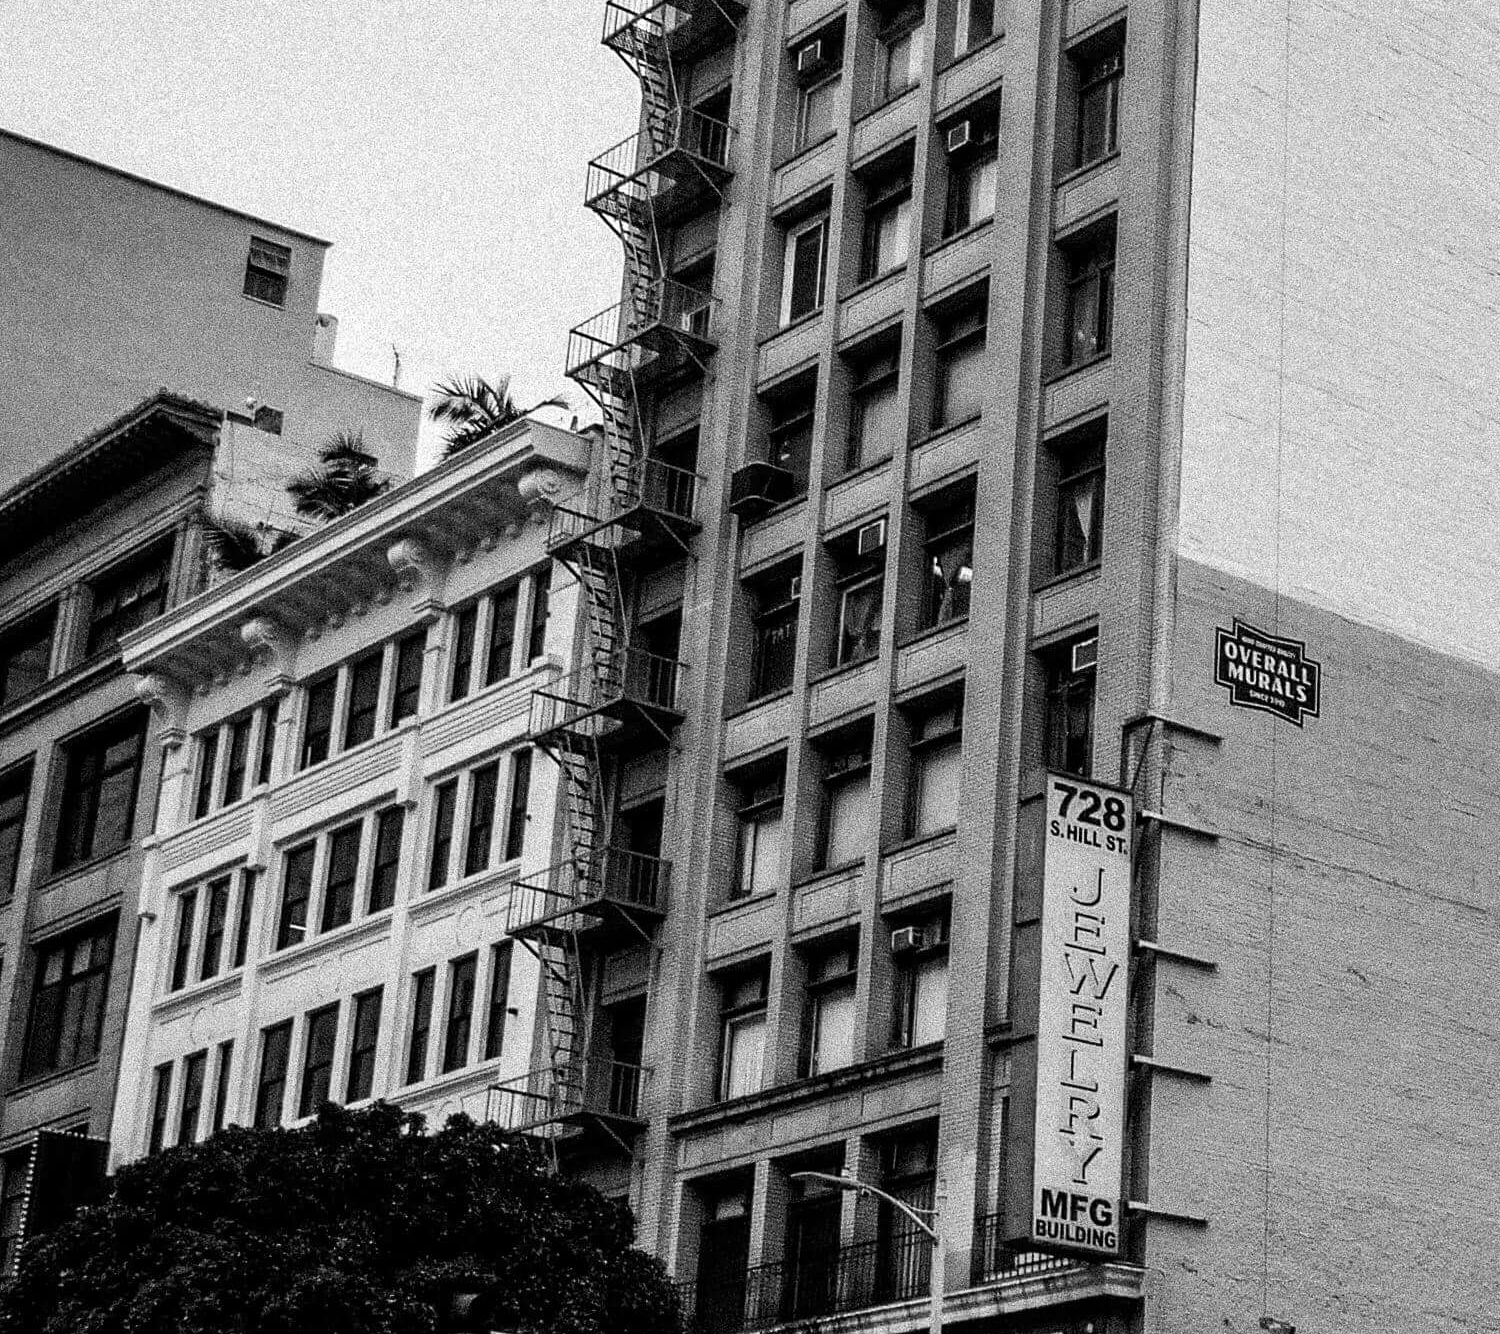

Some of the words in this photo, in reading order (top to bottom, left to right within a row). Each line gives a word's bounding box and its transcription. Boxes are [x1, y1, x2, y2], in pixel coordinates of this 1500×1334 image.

[1224, 640, 1313, 687] OVERALL
[1227, 661, 1307, 704] MURALS
[1054, 781, 1125, 832] 728
[1050, 819, 1064, 838] S.
[1066, 824, 1101, 848] HILL
[1106, 834, 1128, 855] ST.
[1041, 1188, 1113, 1227] MFG
[1036, 1218, 1117, 1249] BUILDING
